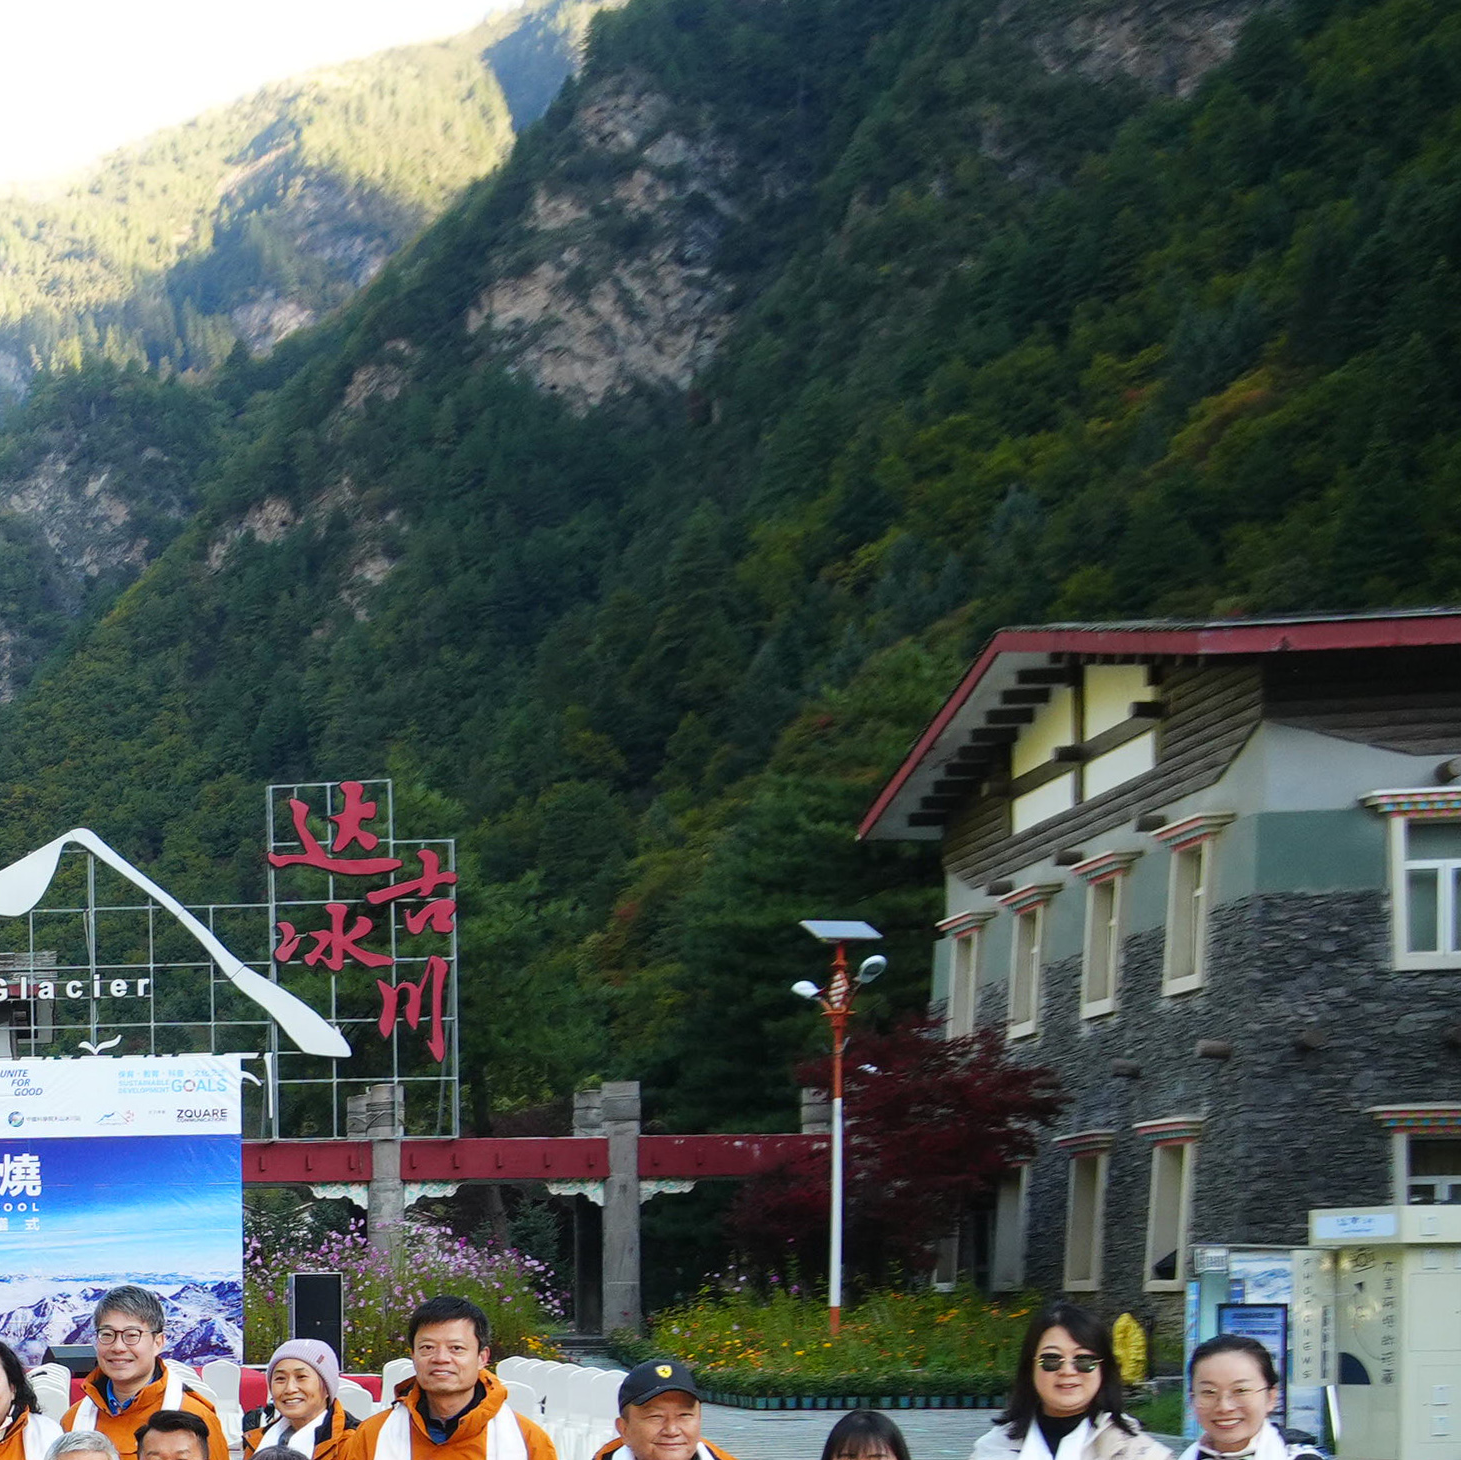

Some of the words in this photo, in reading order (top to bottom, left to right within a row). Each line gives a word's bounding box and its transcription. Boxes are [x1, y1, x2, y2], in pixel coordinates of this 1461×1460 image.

[0, 1069, 28, 1078] UNITE
[11, 1079, 30, 1087] FOR
[171, 1078, 227, 1092] GOALS
[14, 1088, 44, 1097] GOOD
[177, 1108, 228, 1118] ZQUARE
